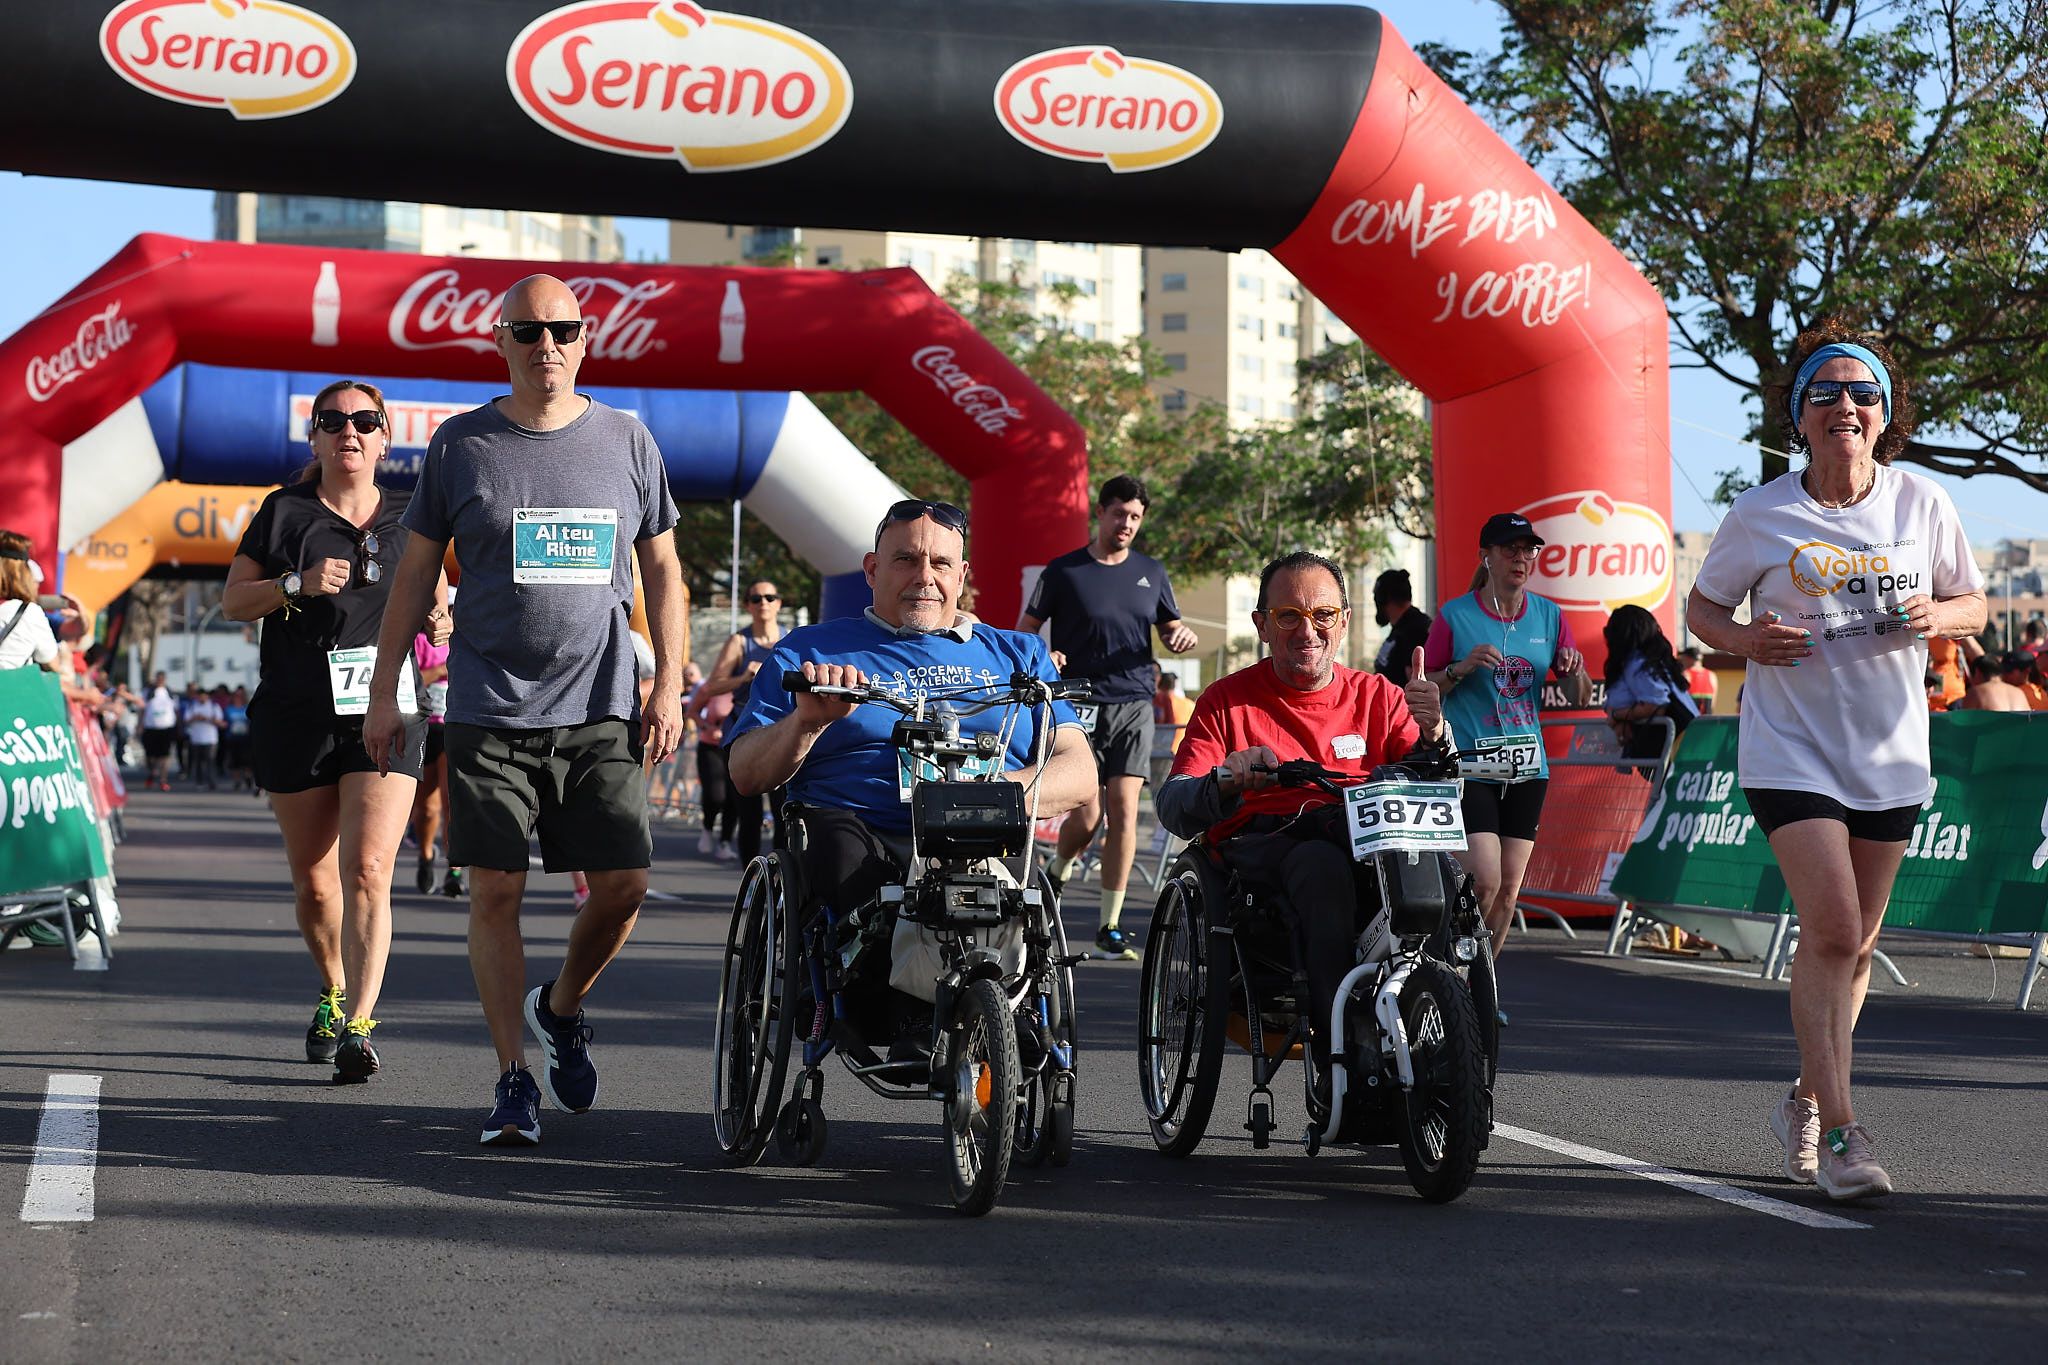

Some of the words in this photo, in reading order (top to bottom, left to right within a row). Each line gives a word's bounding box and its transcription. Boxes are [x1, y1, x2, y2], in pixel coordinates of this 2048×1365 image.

[130, 15, 328, 79] Serrano
[547, 36, 816, 119] Serrano
[1021, 77, 1199, 133] Serrano
[1331, 182, 1462, 258] COME
[1458, 188, 1557, 248] BIEN
[535, 524, 557, 540] Al
[561, 526, 594, 540] teu
[1893, 539, 1916, 548] 2023
[546, 541, 597, 557] Ritme
[1530, 542, 1666, 578] errano
[1811, 553, 1889, 577] Volta
[1847, 576, 1867, 594] a
[1878, 572, 1919, 597] peu
[1798, 611, 1839, 620] Quantes
[907, 664, 972, 679] COCEMFE
[910, 674, 973, 688] VALENCIA
[1676, 761, 1735, 802] caixa
[1356, 799, 1455, 828] 5873
[1658, 802, 1756, 853] popular
